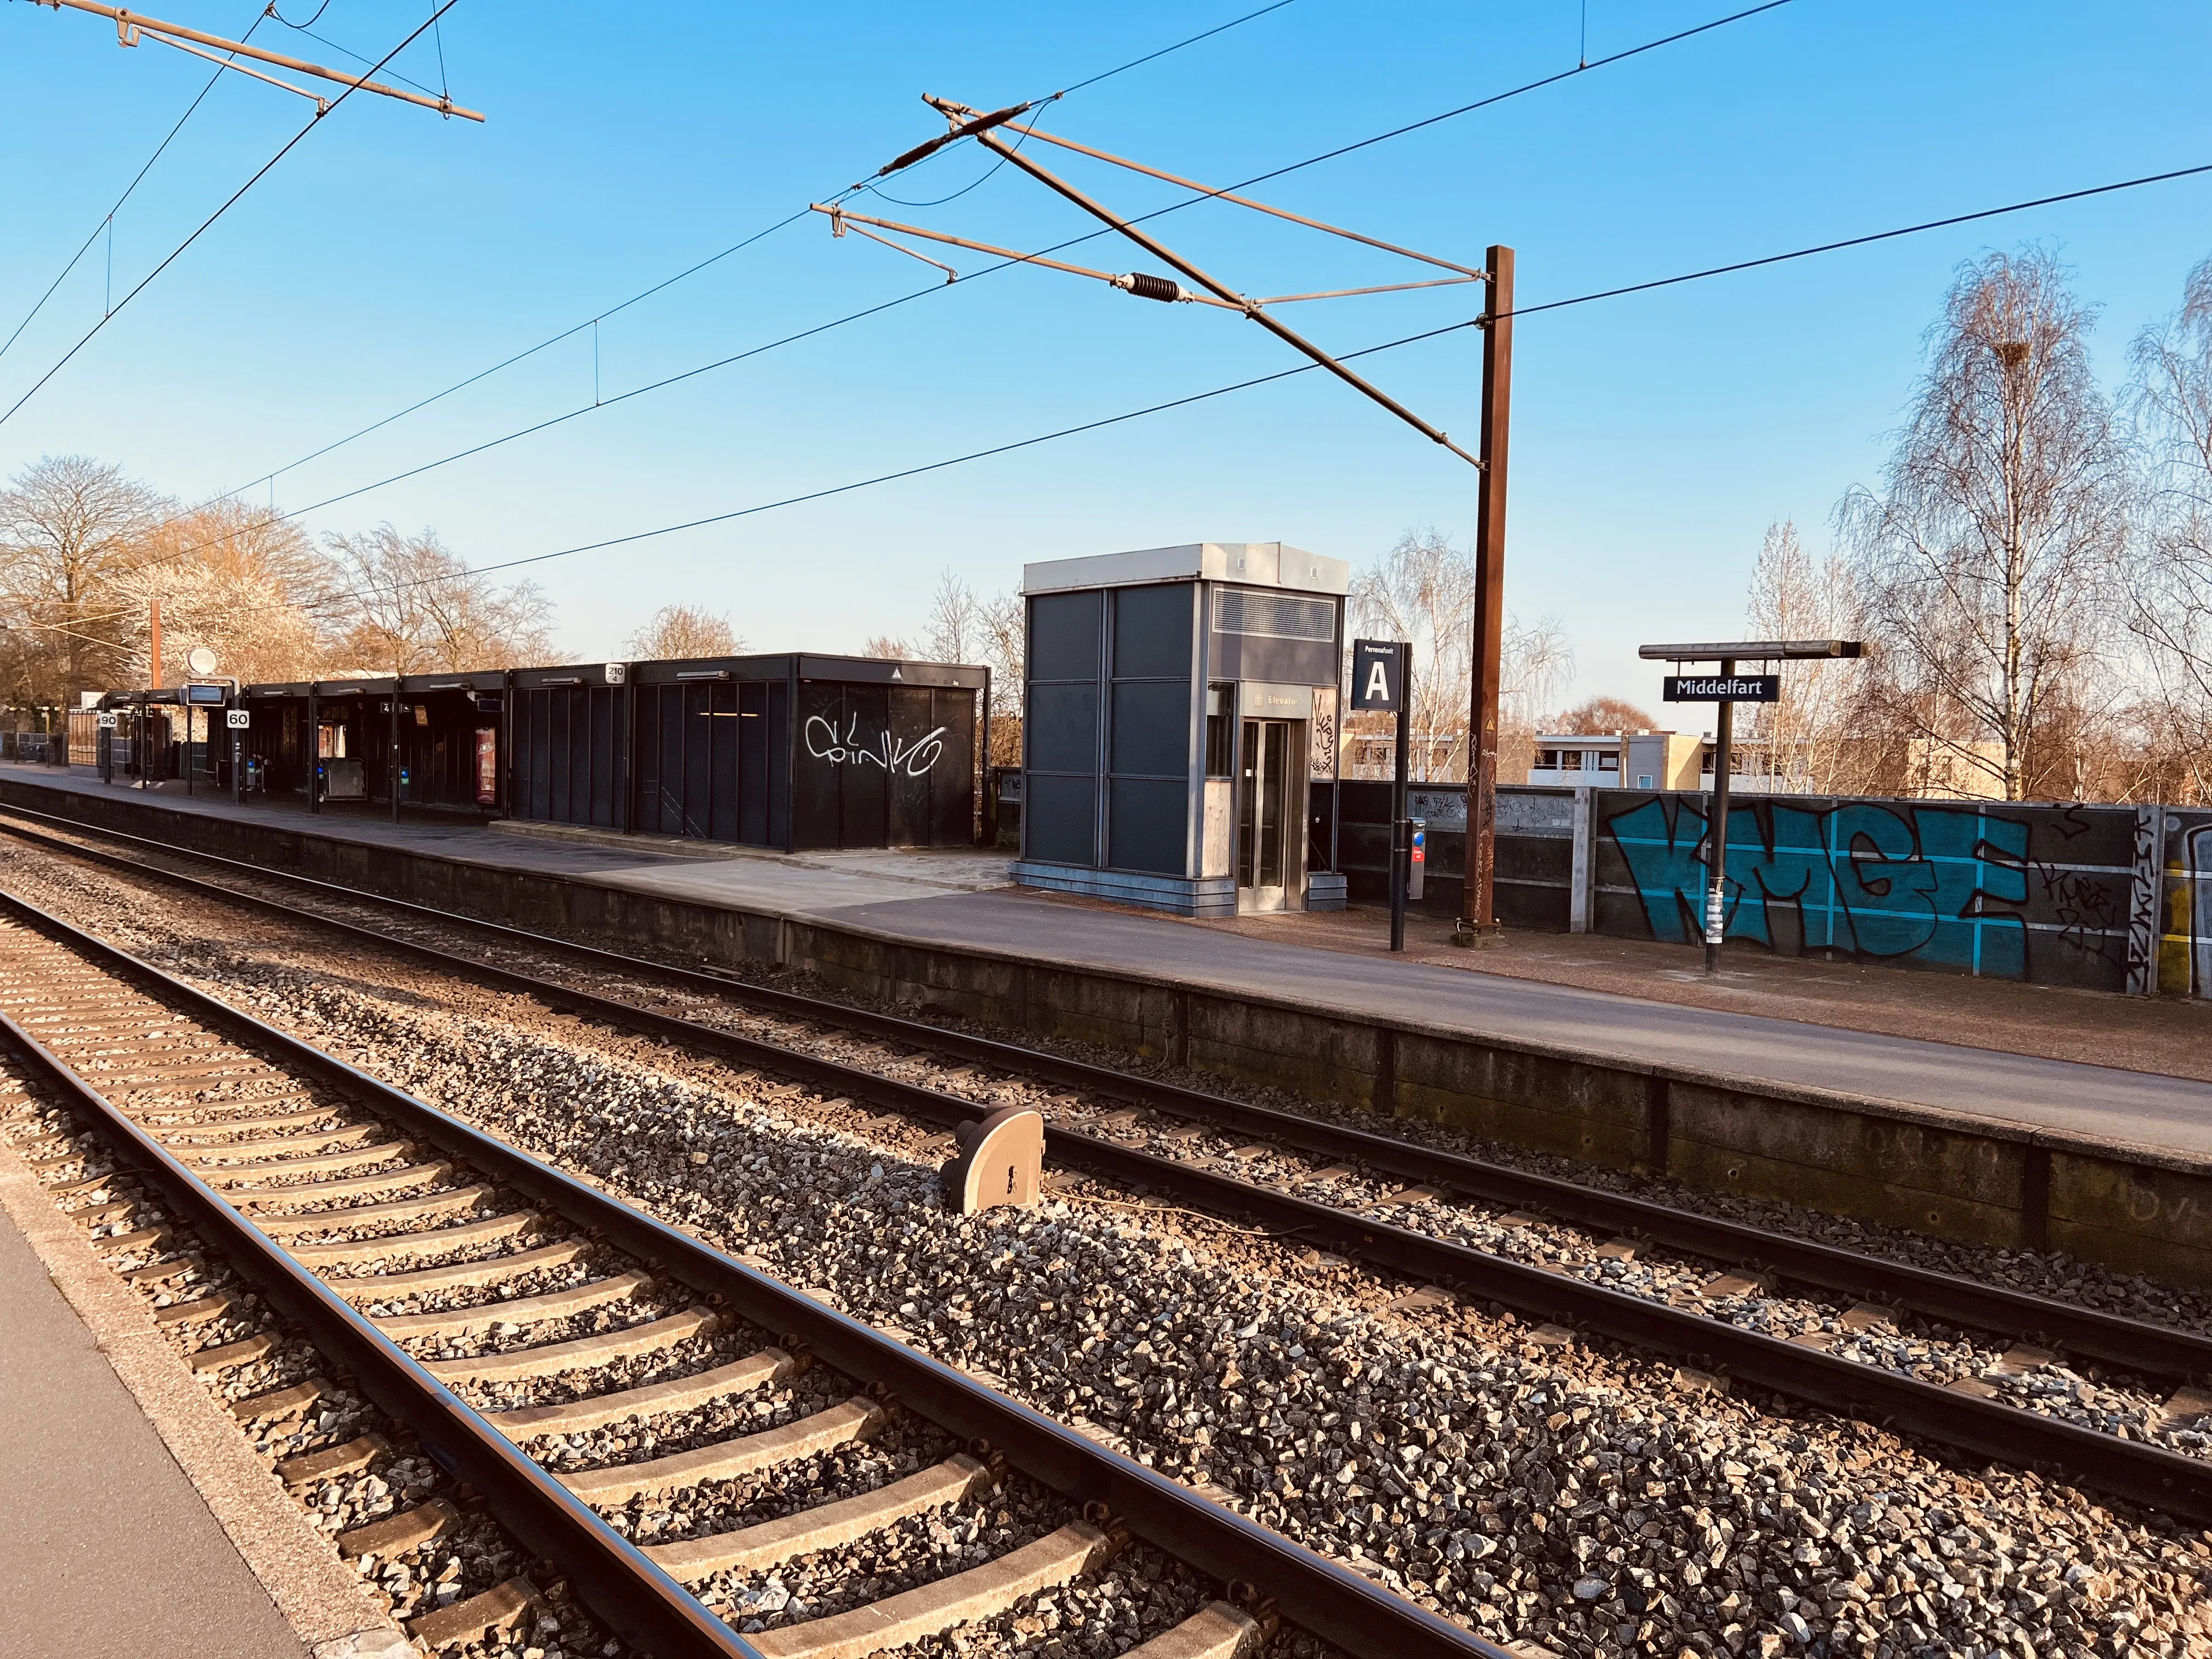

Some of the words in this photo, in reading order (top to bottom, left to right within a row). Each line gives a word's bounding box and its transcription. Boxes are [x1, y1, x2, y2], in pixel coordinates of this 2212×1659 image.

[608, 667, 623, 675] 210
[1365, 661, 1390, 701] A
[1677, 679, 1762, 695] Middelfart
[1268, 695, 1299, 706] Elevator
[101, 716, 116, 725] 90
[229, 714, 247, 724] 60
